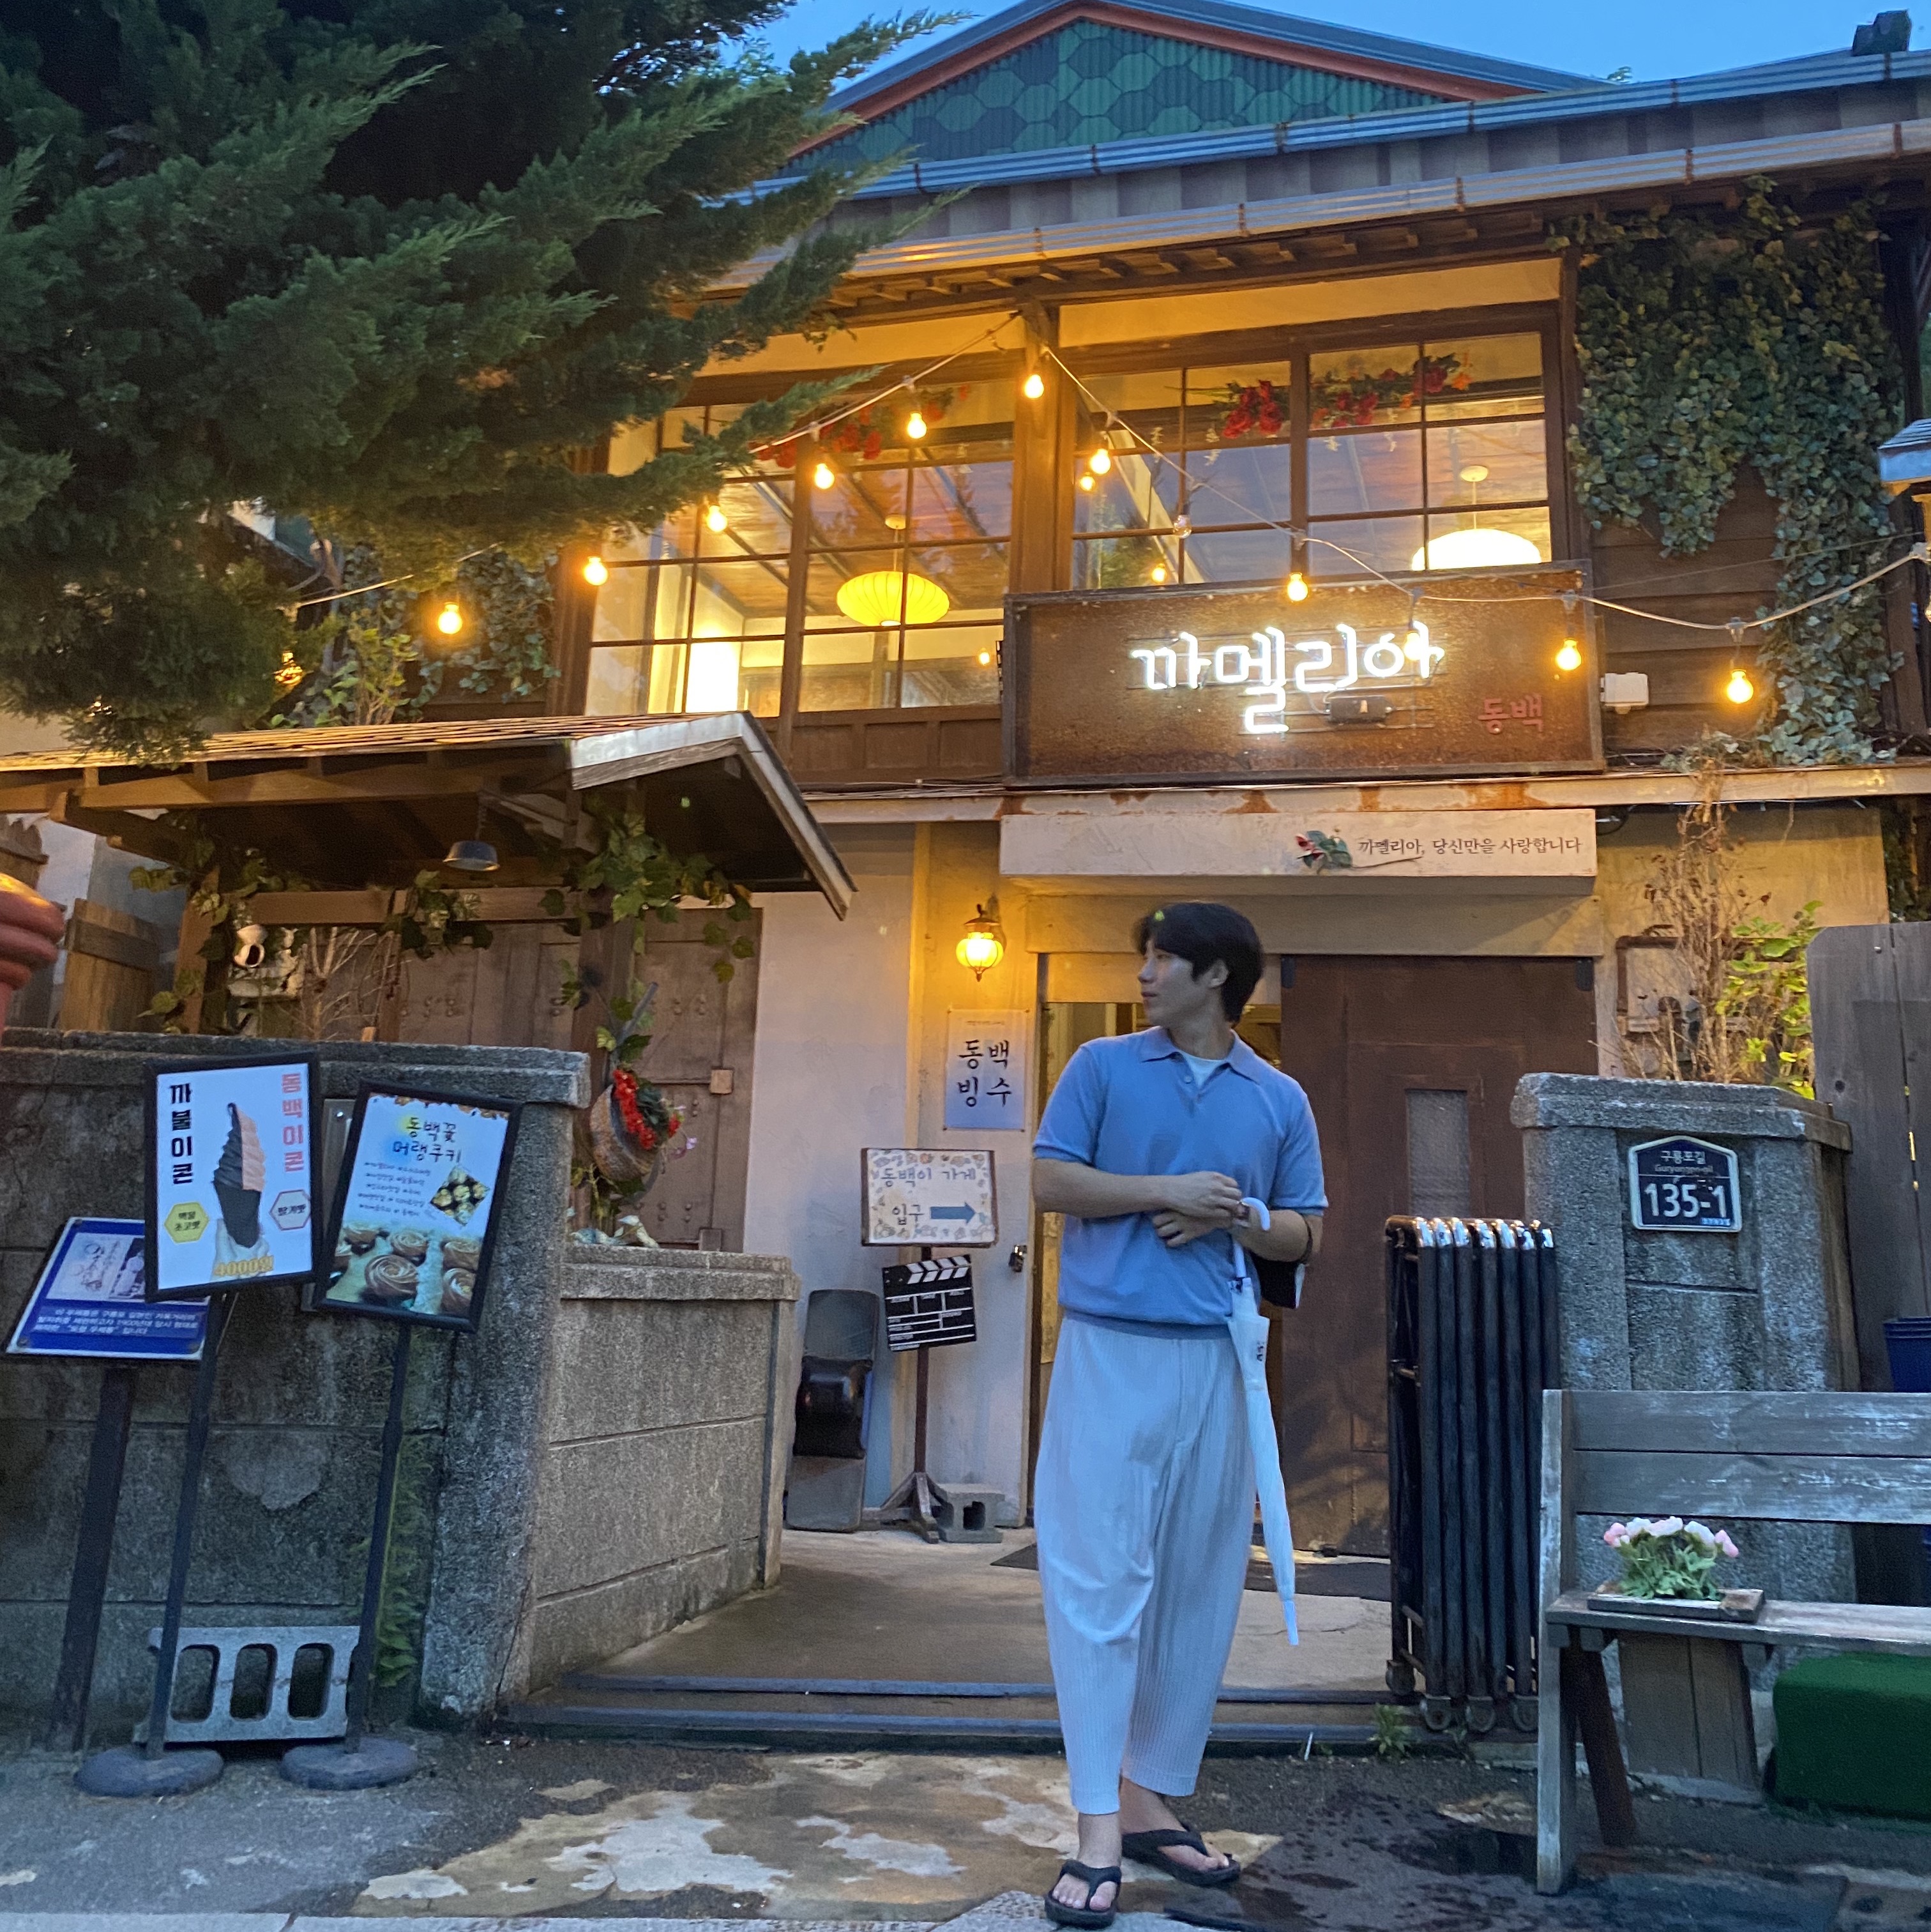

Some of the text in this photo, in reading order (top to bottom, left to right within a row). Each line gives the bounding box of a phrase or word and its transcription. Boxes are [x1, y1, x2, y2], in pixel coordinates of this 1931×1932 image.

[1130, 621, 1445, 734] 까멜리아
[1477, 694, 1545, 734] 동백
[1432, 837, 1497, 855] 당신만을
[1499, 835, 1582, 855] 사랑합니다
[957, 1039, 1010, 1069] 동백
[957, 1076, 1012, 1107] 빙수
[169, 1083, 194, 1185] 까불이콘
[282, 1073, 305, 1173] 동백이콘
[406, 1117, 457, 1143] 동백꽃
[392, 1141, 462, 1164] 머랭쿠키
[880, 1167, 976, 1187] 동백이 가게
[891, 1203, 925, 1227] 입구
[1644, 1183, 1727, 1218] 135-1
